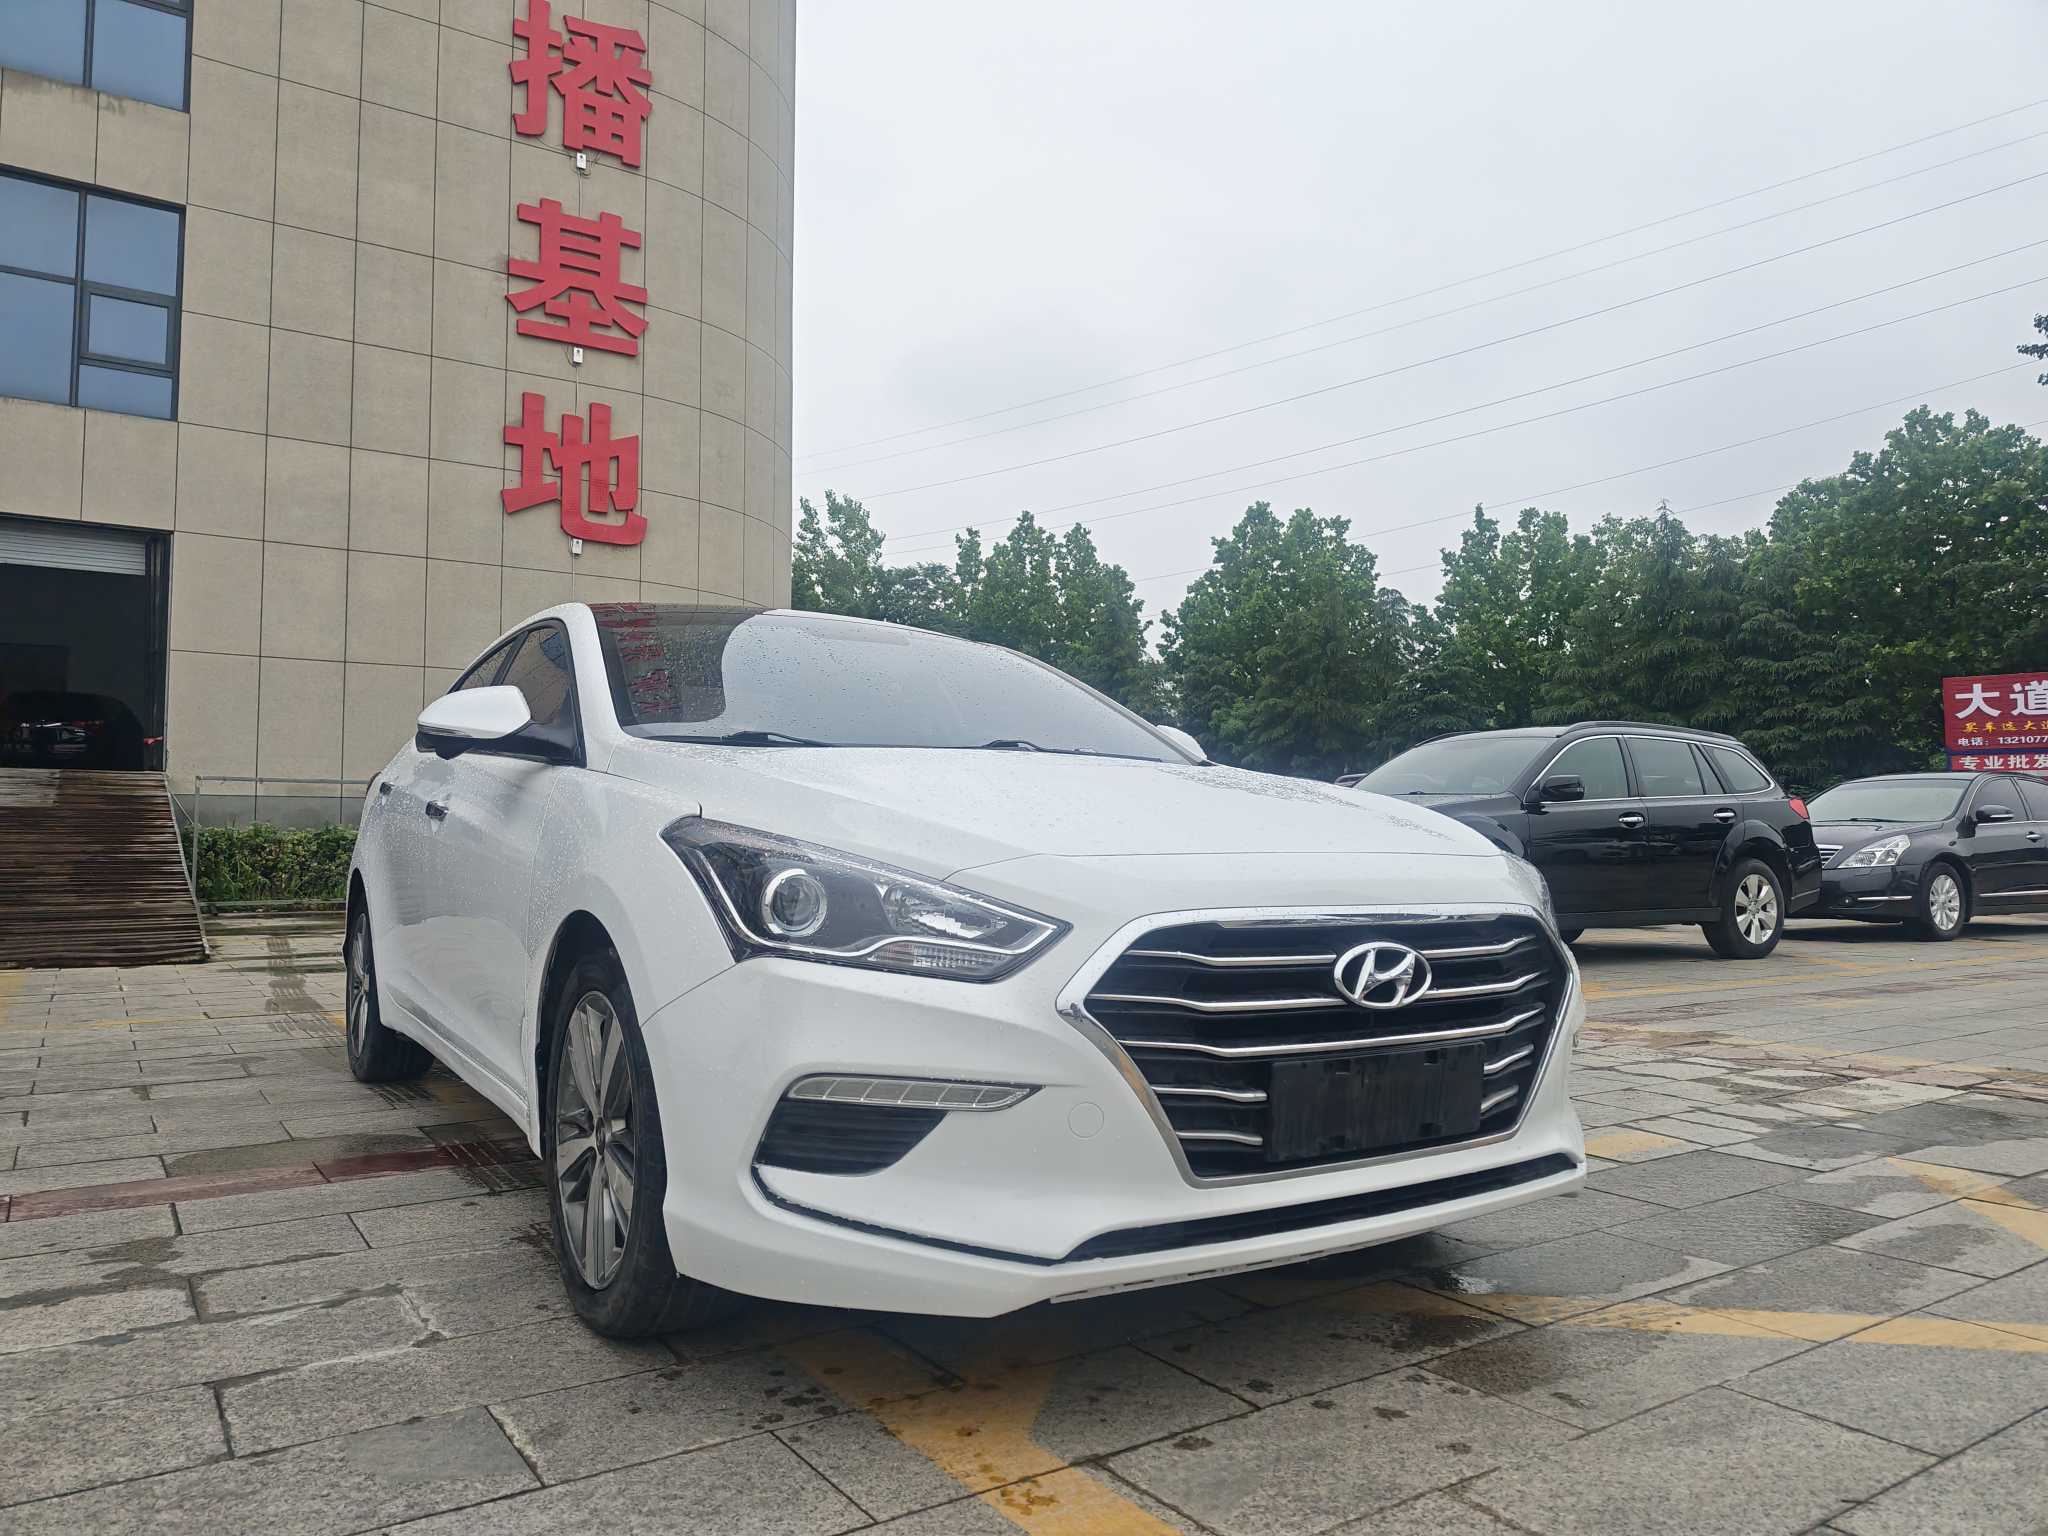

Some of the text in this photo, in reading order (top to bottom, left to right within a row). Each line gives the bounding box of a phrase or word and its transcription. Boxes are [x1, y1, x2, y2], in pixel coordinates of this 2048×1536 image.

[501, 0, 653, 546] 播基地
[1954, 680, 2048, 719] 大道
[1959, 753, 2048, 770] 专业批发
